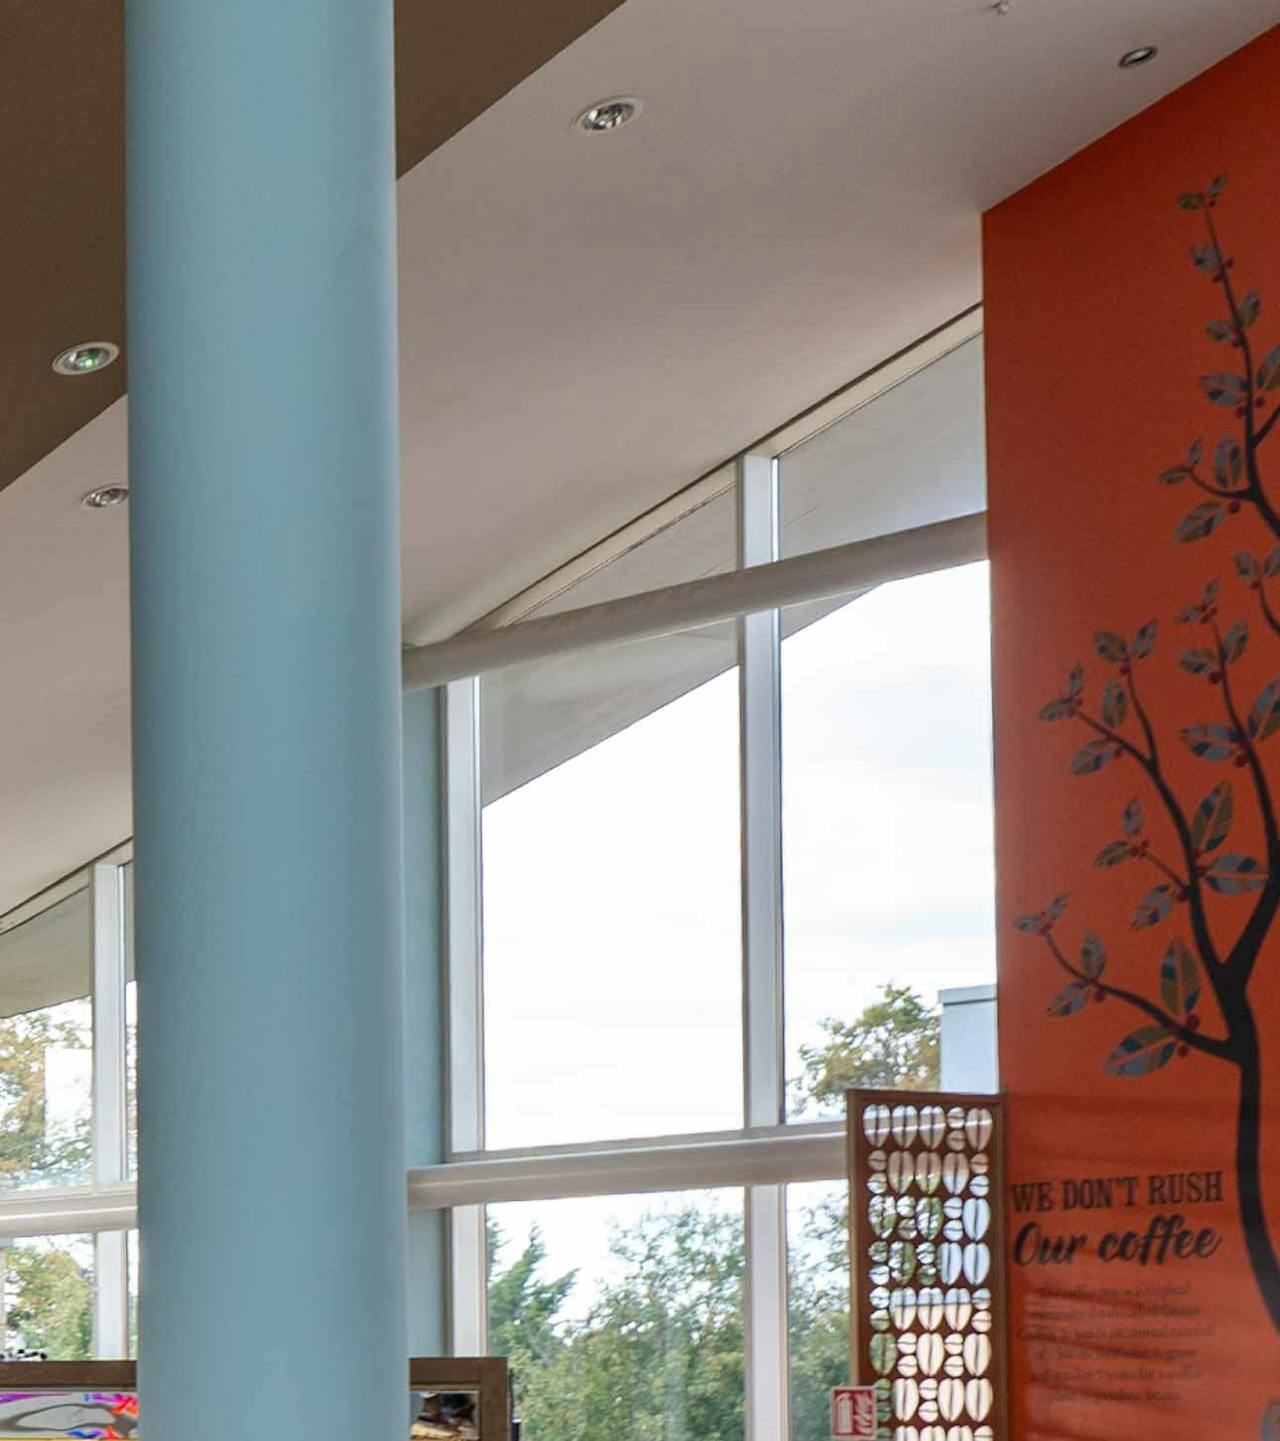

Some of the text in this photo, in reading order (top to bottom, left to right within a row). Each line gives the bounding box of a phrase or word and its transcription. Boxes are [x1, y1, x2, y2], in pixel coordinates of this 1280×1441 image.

[1011, 1171, 1224, 1213] WE DON'T RUSH
[1013, 1213, 1223, 1267] Our coffee
